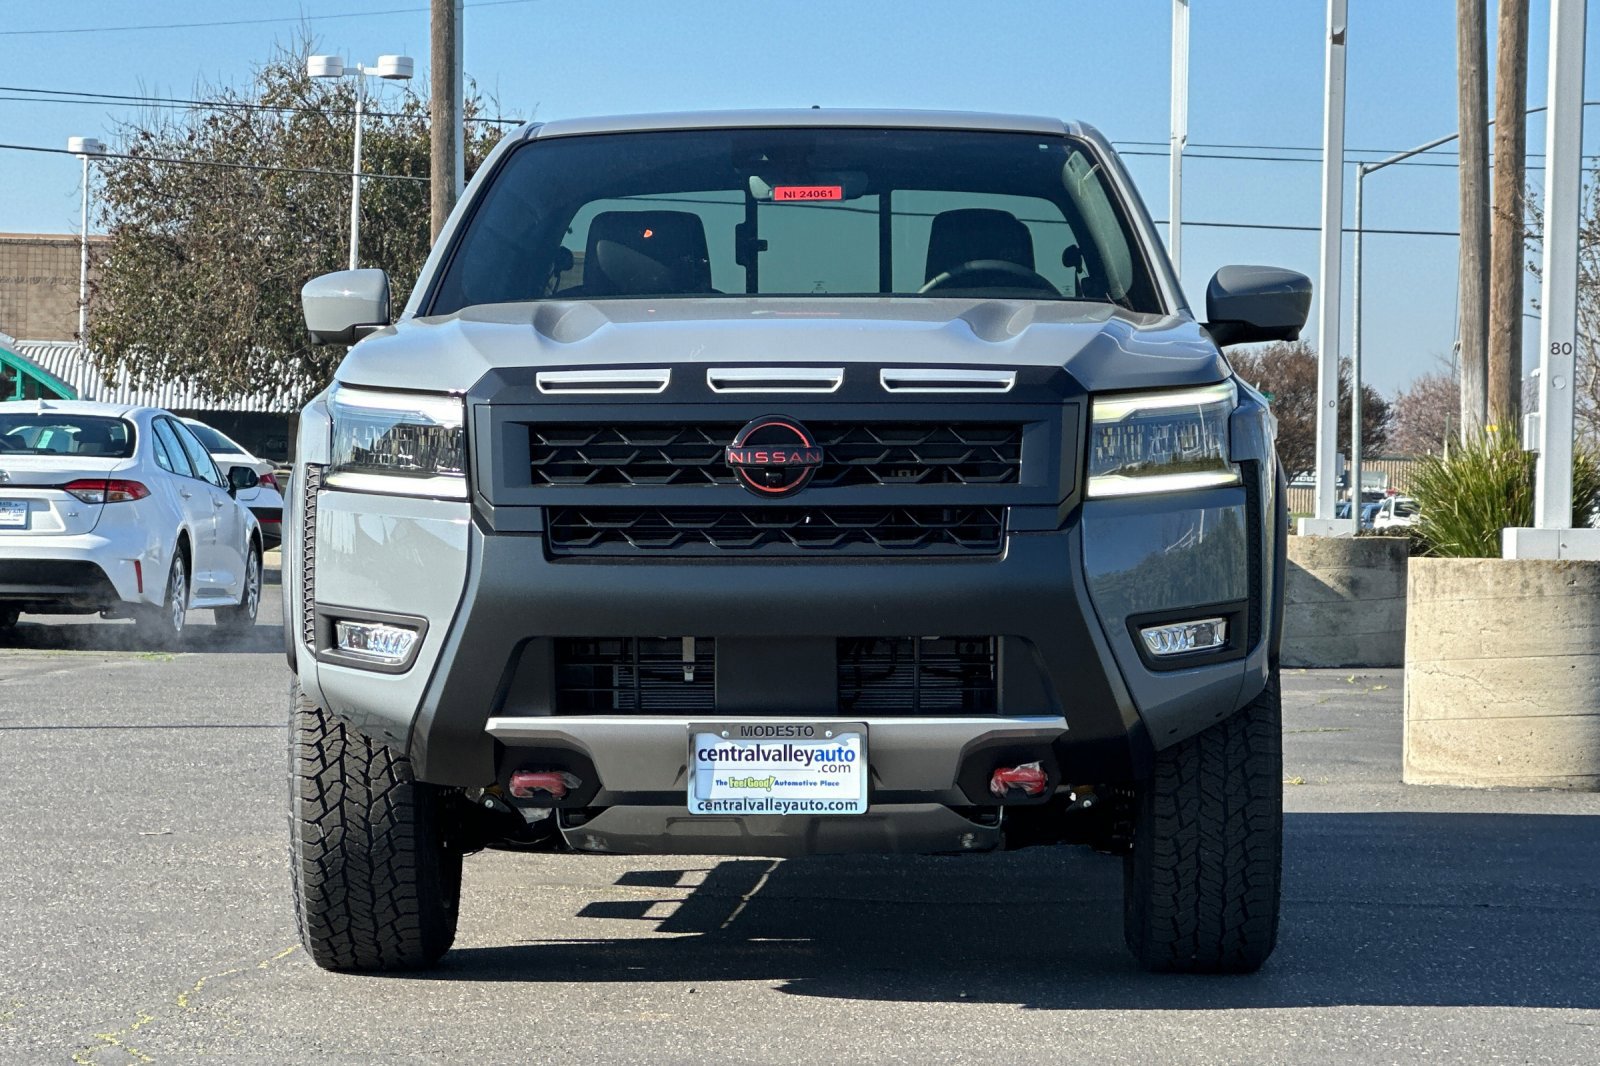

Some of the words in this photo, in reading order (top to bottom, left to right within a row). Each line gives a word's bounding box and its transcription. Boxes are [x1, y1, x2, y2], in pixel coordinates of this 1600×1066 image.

[800, 189, 833, 198] 24061
[1550, 341, 1573, 356] 80
[729, 451, 820, 464] NISSAN
[740, 725, 815, 737] MODESTO
[698, 743, 856, 767] centralvalleyauto
[817, 763, 851, 773] .com
[715, 779, 728, 787] The
[774, 779, 818, 787] Automotive
[819, 779, 840, 787] Place
[697, 797, 858, 814] centralvalleyauto.com
